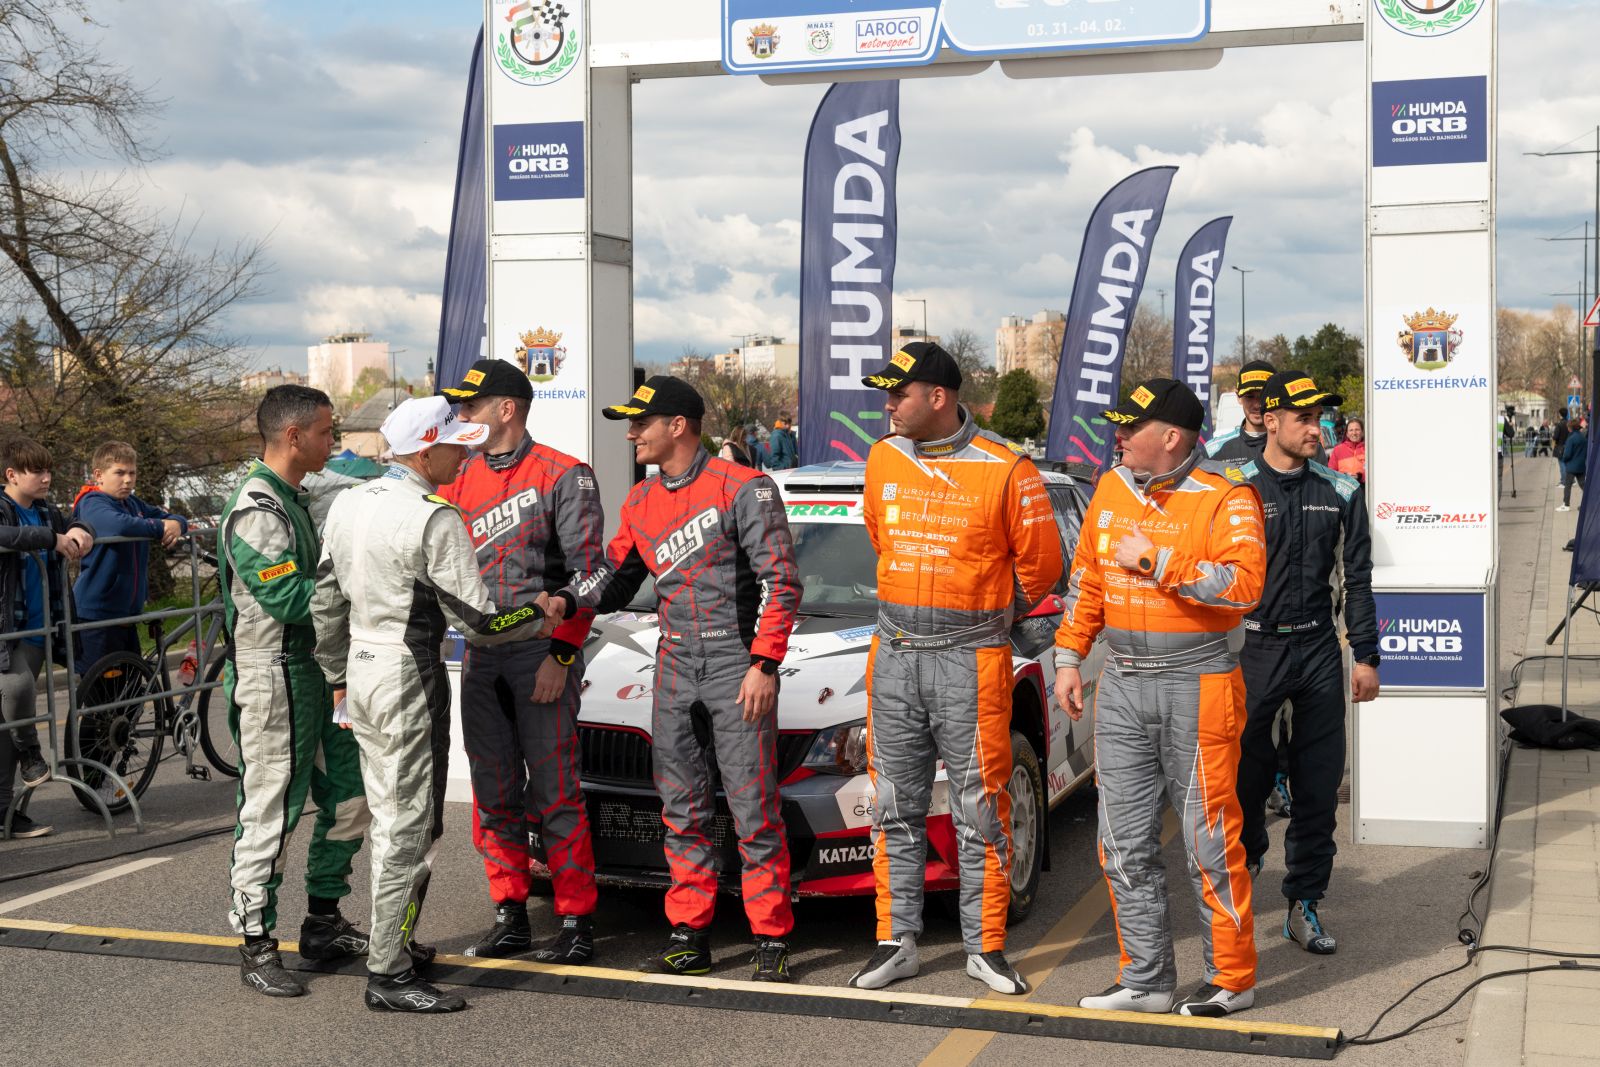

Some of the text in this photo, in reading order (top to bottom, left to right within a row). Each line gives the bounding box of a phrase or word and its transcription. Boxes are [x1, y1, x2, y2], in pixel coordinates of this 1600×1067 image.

[857, 20, 919, 37] LAROCO
[1027, 24, 1048, 36] 03.
[1105, 19, 1126, 32] 02.
[860, 36, 914, 54] motorsport
[1409, 101, 1467, 116] HUMDA
[1391, 117, 1468, 135] ORB
[522, 143, 569, 157] HUMDA
[509, 157, 569, 173] ORB
[830, 109, 889, 390] HUMDA
[1076, 208, 1153, 405] HUMDA
[1186, 249, 1220, 401] HUMDA
[1374, 375, 1487, 390] SZÉKESFEHÉRVÁR
[533, 388, 586, 399] FEHÉRVÁR
[1265, 396, 1280, 409] 1ST
[1396, 513, 1488, 524] TEREPRALLY
[1399, 619, 1462, 633] HUMDA
[701, 630, 728, 639] RANGA
[1380, 635, 1463, 653] ORB
